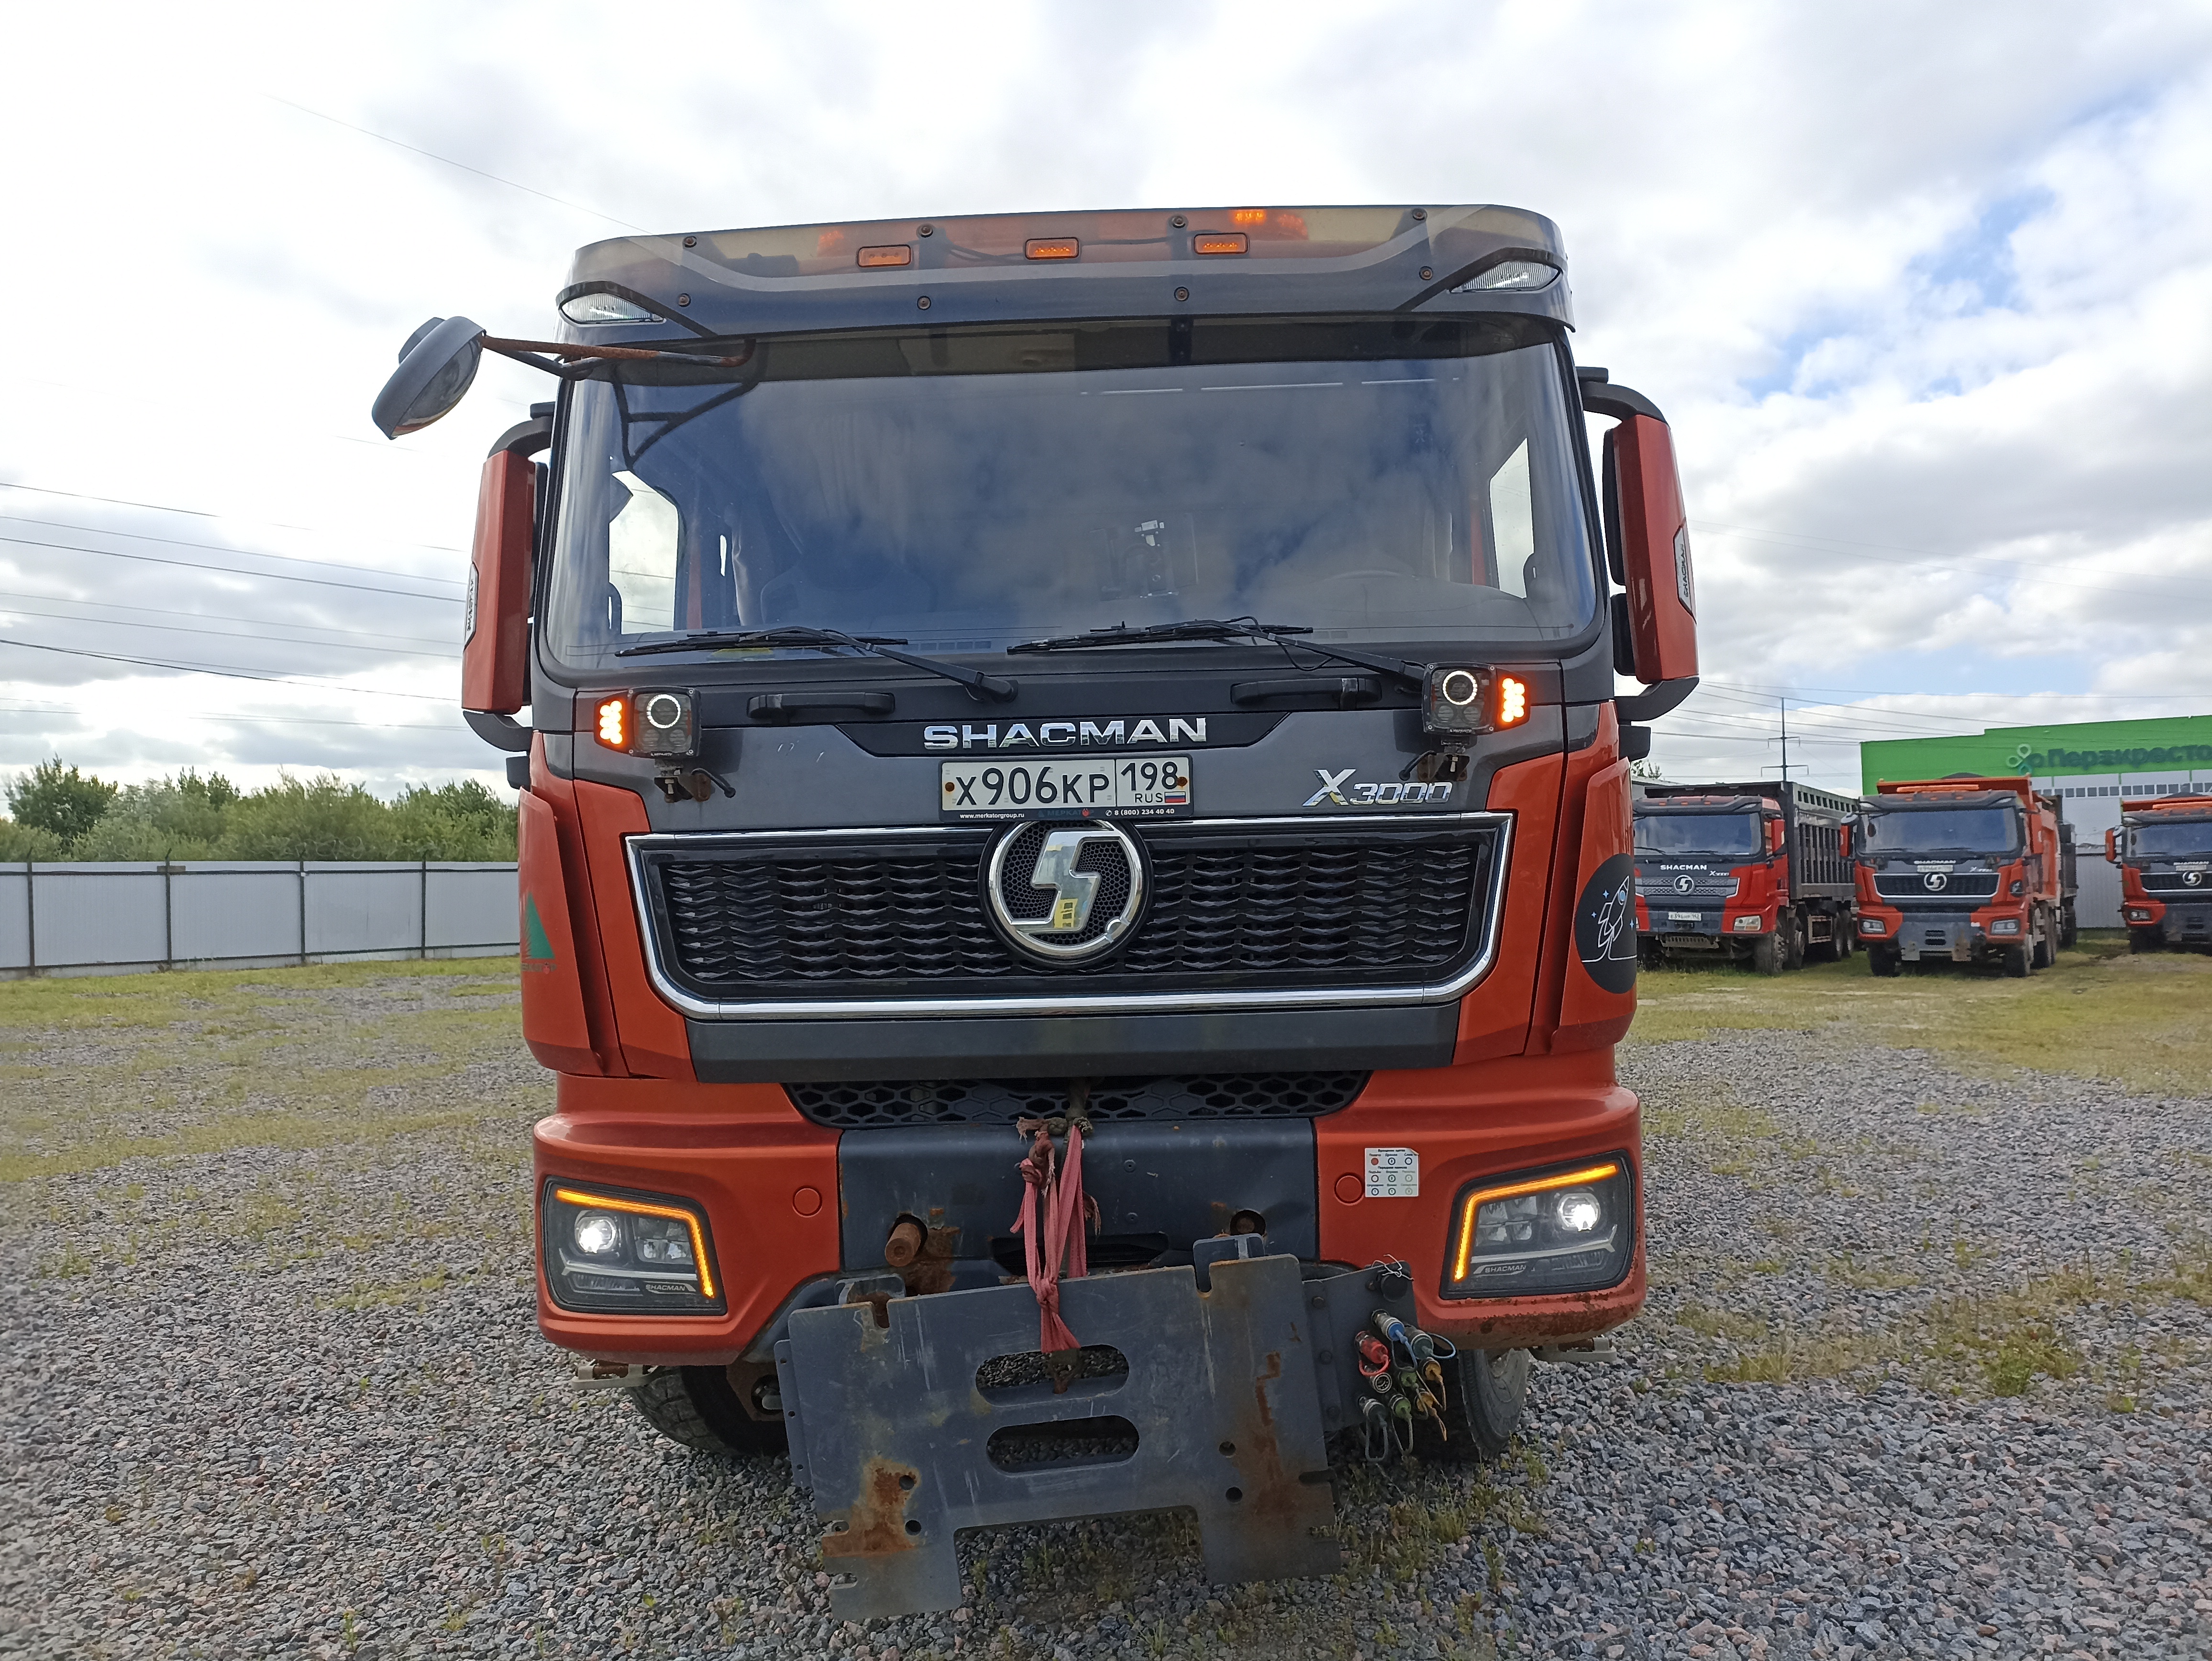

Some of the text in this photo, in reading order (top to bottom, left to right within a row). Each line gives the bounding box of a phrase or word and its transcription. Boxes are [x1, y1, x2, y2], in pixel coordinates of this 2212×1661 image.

[924, 718, 1206, 750] SHACMAN
[956, 761, 1179, 806] Х906КР 198
[1135, 792, 1163, 803] RUS
[1302, 769, 1452, 807] X3000
[1485, 1265, 1526, 1273] SHACMAN
